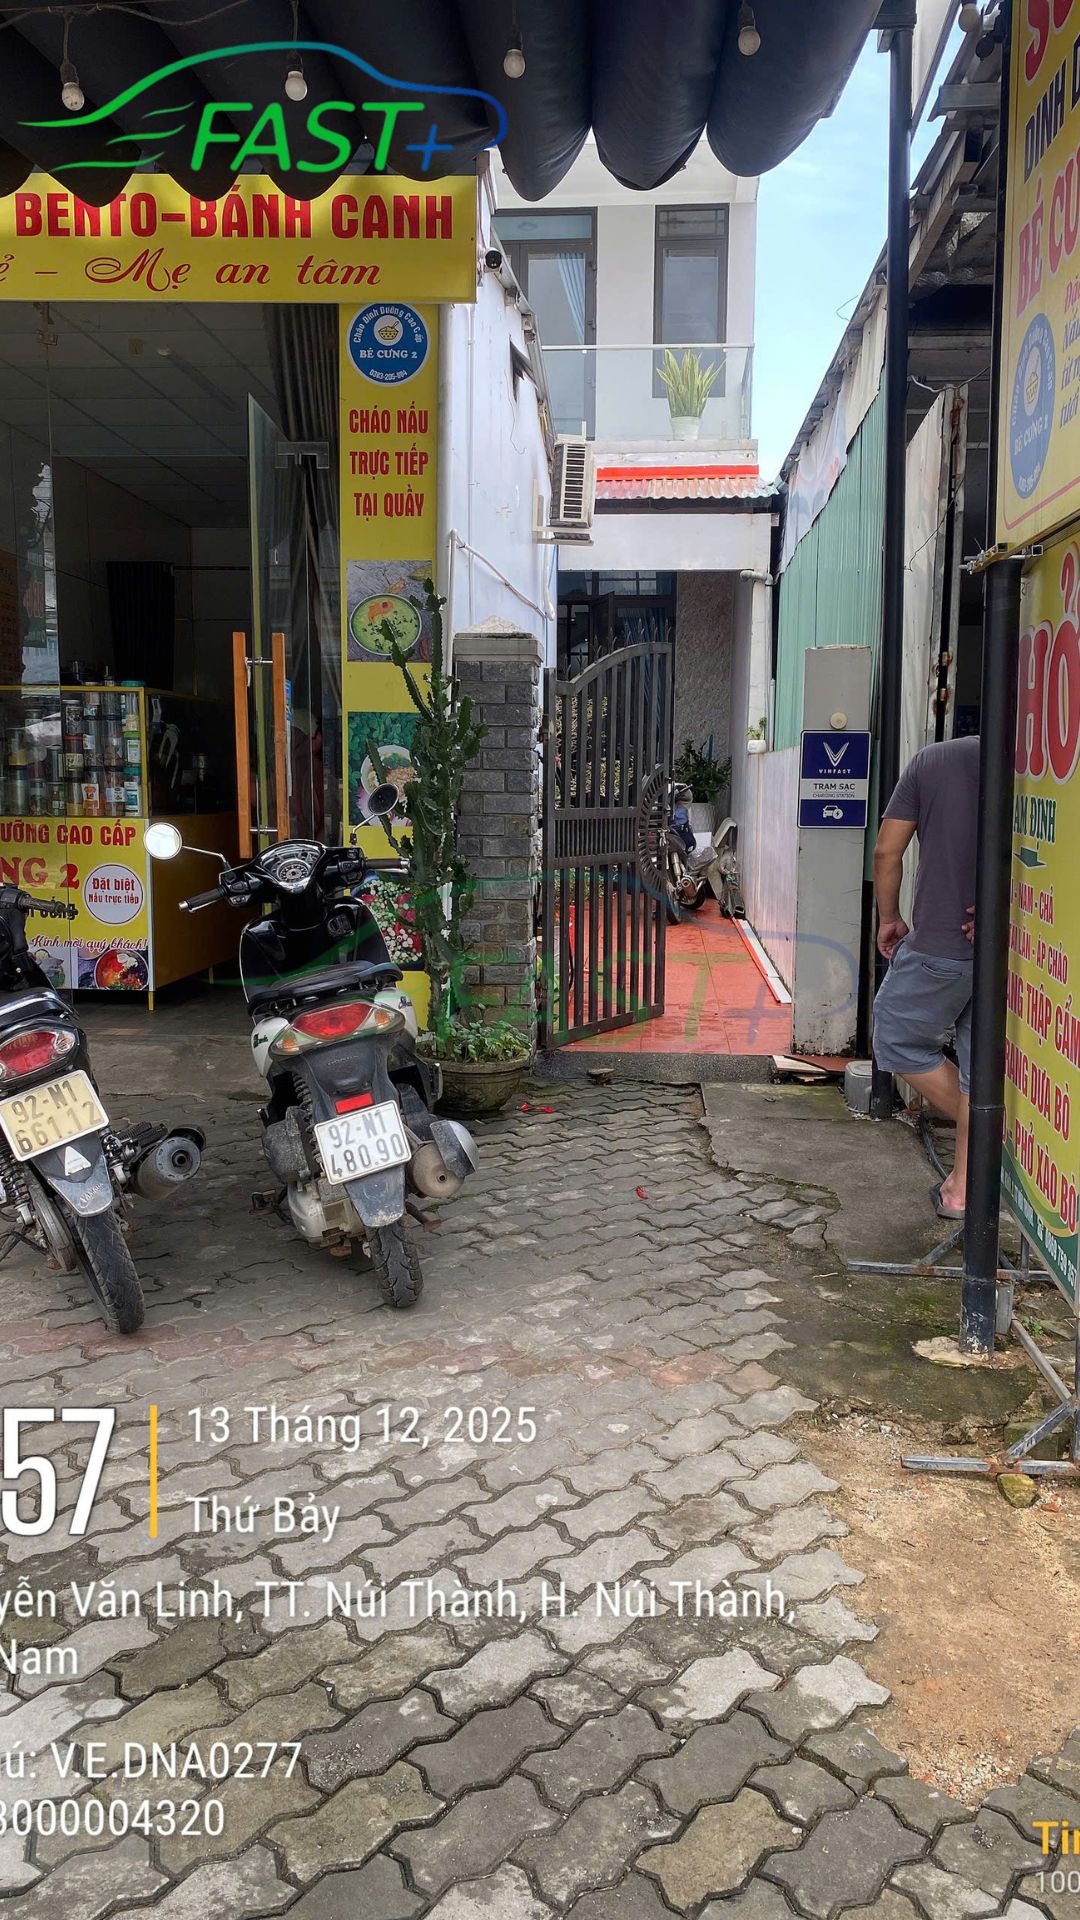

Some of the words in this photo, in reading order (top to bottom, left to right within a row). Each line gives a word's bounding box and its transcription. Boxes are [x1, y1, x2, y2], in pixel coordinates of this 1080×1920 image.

[1024, 58, 1066, 184] DINH
[331, 193, 453, 240] CANH
[1017, 177, 1043, 318] BÉ
[84, 248, 191, 292] Mẹ
[216, 259, 270, 285] an
[297, 254, 382, 286] tâm
[404, 312, 417, 327] Cao
[359, 347, 374, 359] BÉ
[376, 348, 409, 359] CƯNG
[411, 351, 418, 359] 2
[349, 405, 391, 434] CHÁO
[397, 401, 429, 434] NẤU
[350, 449, 390, 480] TRỰC
[395, 443, 429, 475] TIẾP
[354, 492, 378, 522] TẠI
[384, 484, 425, 517] QUẦY
[814, 783, 837, 791] TRẠM
[839, 783, 856, 791] SẠC
[57, 825, 93, 846] CAO
[100, 819, 137, 847] CẤP
[1030, 797, 1056, 851] ĐỊNH
[0, 857, 48, 887] NG
[59, 863, 80, 890] 2
[92, 877, 111, 893] Đặt
[114, 878, 135, 894] biệt
[88, 891, 103, 904] Nấu
[105, 894, 122, 906] trực
[124, 892, 140, 904] tiếp
[1018, 882, 1034, 917] NẠM
[1039, 885, 1054, 925] CHẢ
[31, 935, 59, 949] Kính
[63, 938, 83, 948] mời
[86, 938, 106, 953] quý
[110, 935, 148, 951] khách!
[1036, 934, 1047, 969] ÁP
[1048, 941, 1068, 985] CHẢO
[1027, 984, 1052, 1046] THẬP
[11, 1080, 78, 1123] 92-N1
[1004, 1039, 1028, 1097] RANG
[1031, 1062, 1051, 1123] DƯA
[1055, 1083, 1070, 1141] BÒ
[328, 1109, 387, 1148] 92-N1
[331, 1133, 404, 1177] 480.90
[1014, 1122, 1035, 1177] PHỞ
[1036, 1144, 1058, 1208] XÀO
[1060, 1174, 1077, 1234] BÒ
